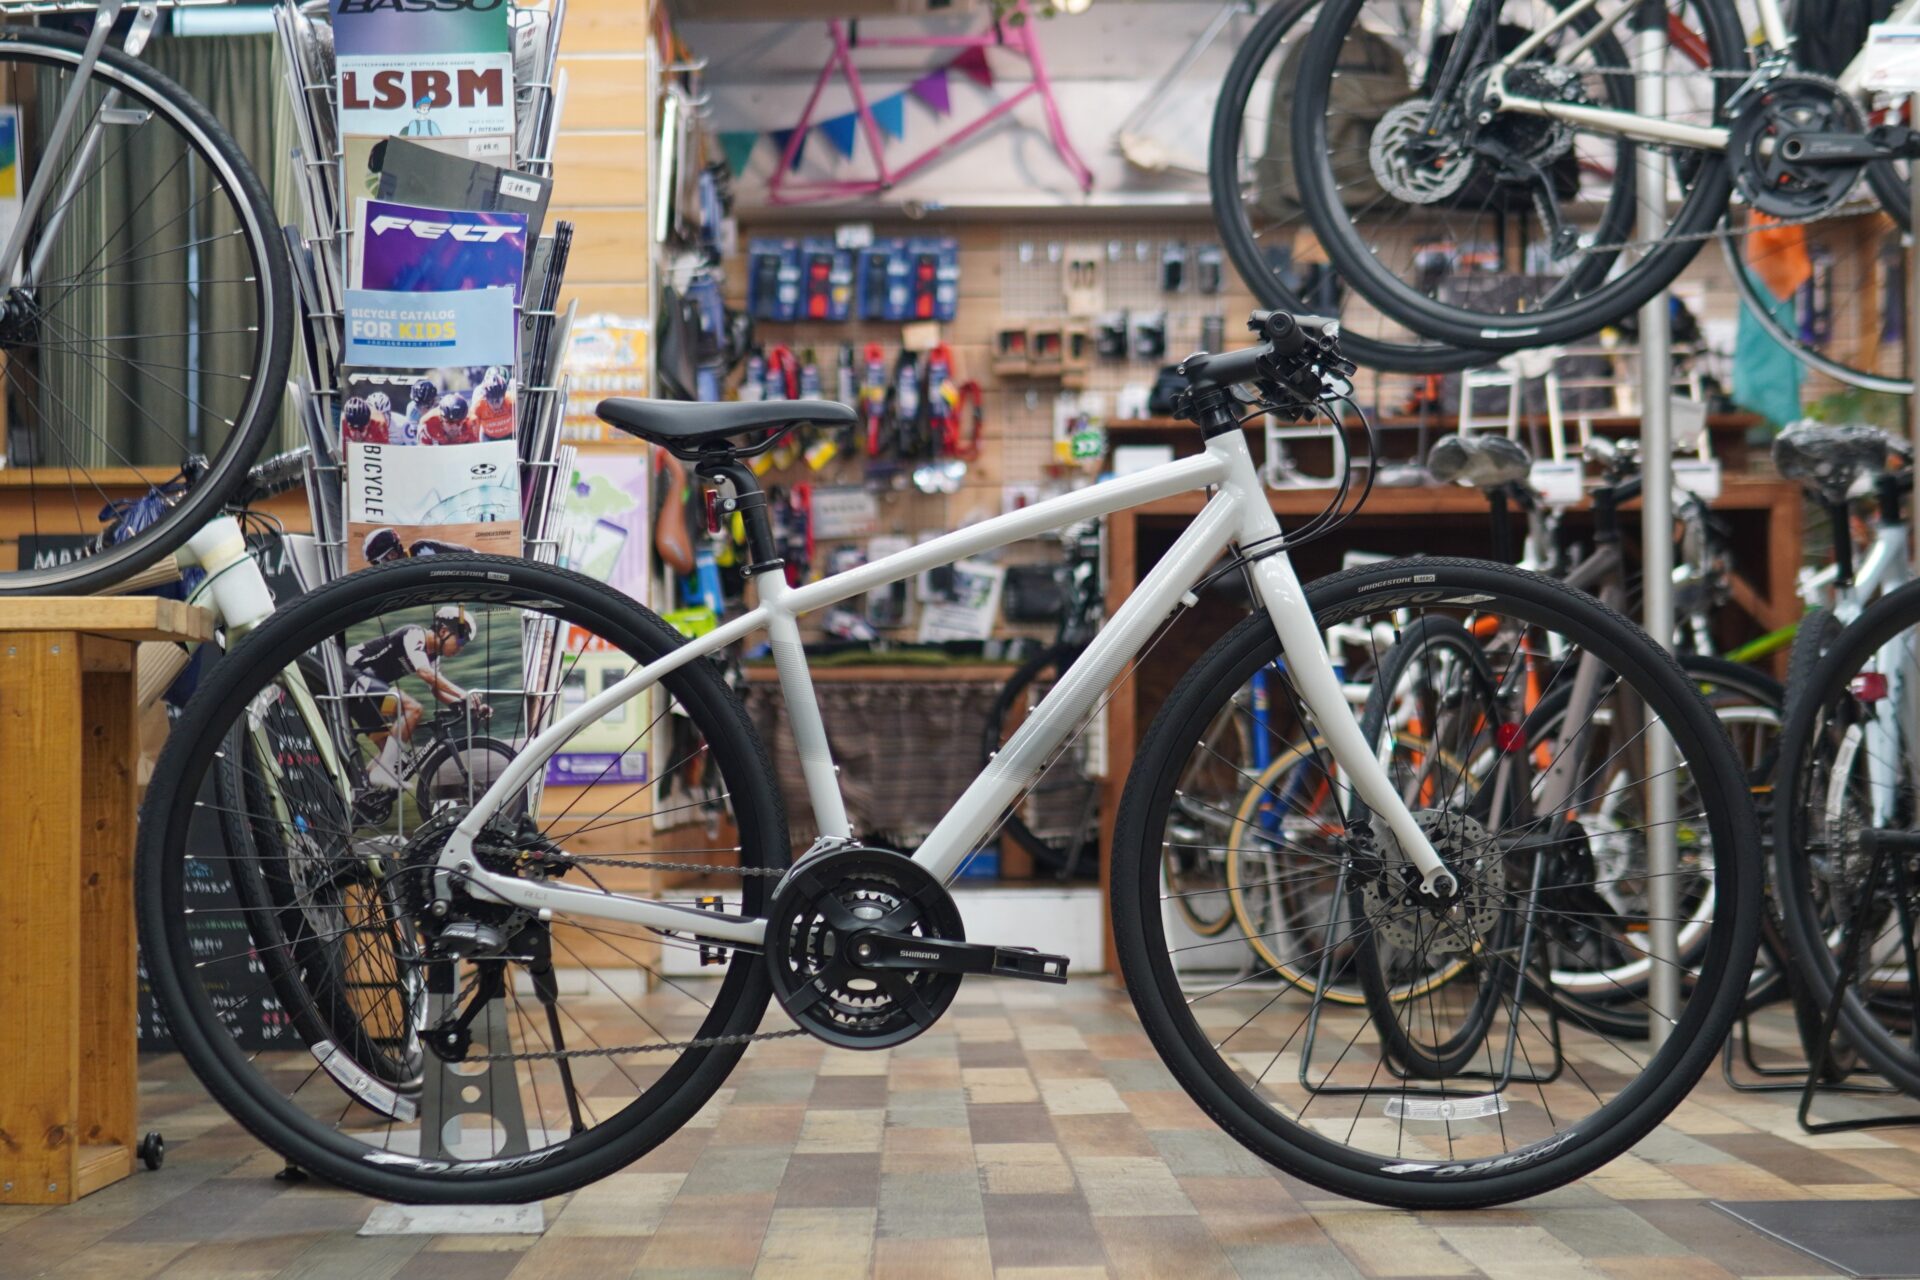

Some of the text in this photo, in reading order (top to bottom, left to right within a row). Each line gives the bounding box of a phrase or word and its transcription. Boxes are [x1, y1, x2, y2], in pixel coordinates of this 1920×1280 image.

[342, 68, 504, 110] LSBM
[370, 215, 522, 243] FELT
[351, 308, 456, 320] BICYCLE CATALOG
[352, 320, 457, 339] FOR KIDS
[363, 444, 384, 517] BICYCLE
[1358, 576, 1412, 592] BRIDGESTONE
[900, 950, 940, 960] SHIMANO
